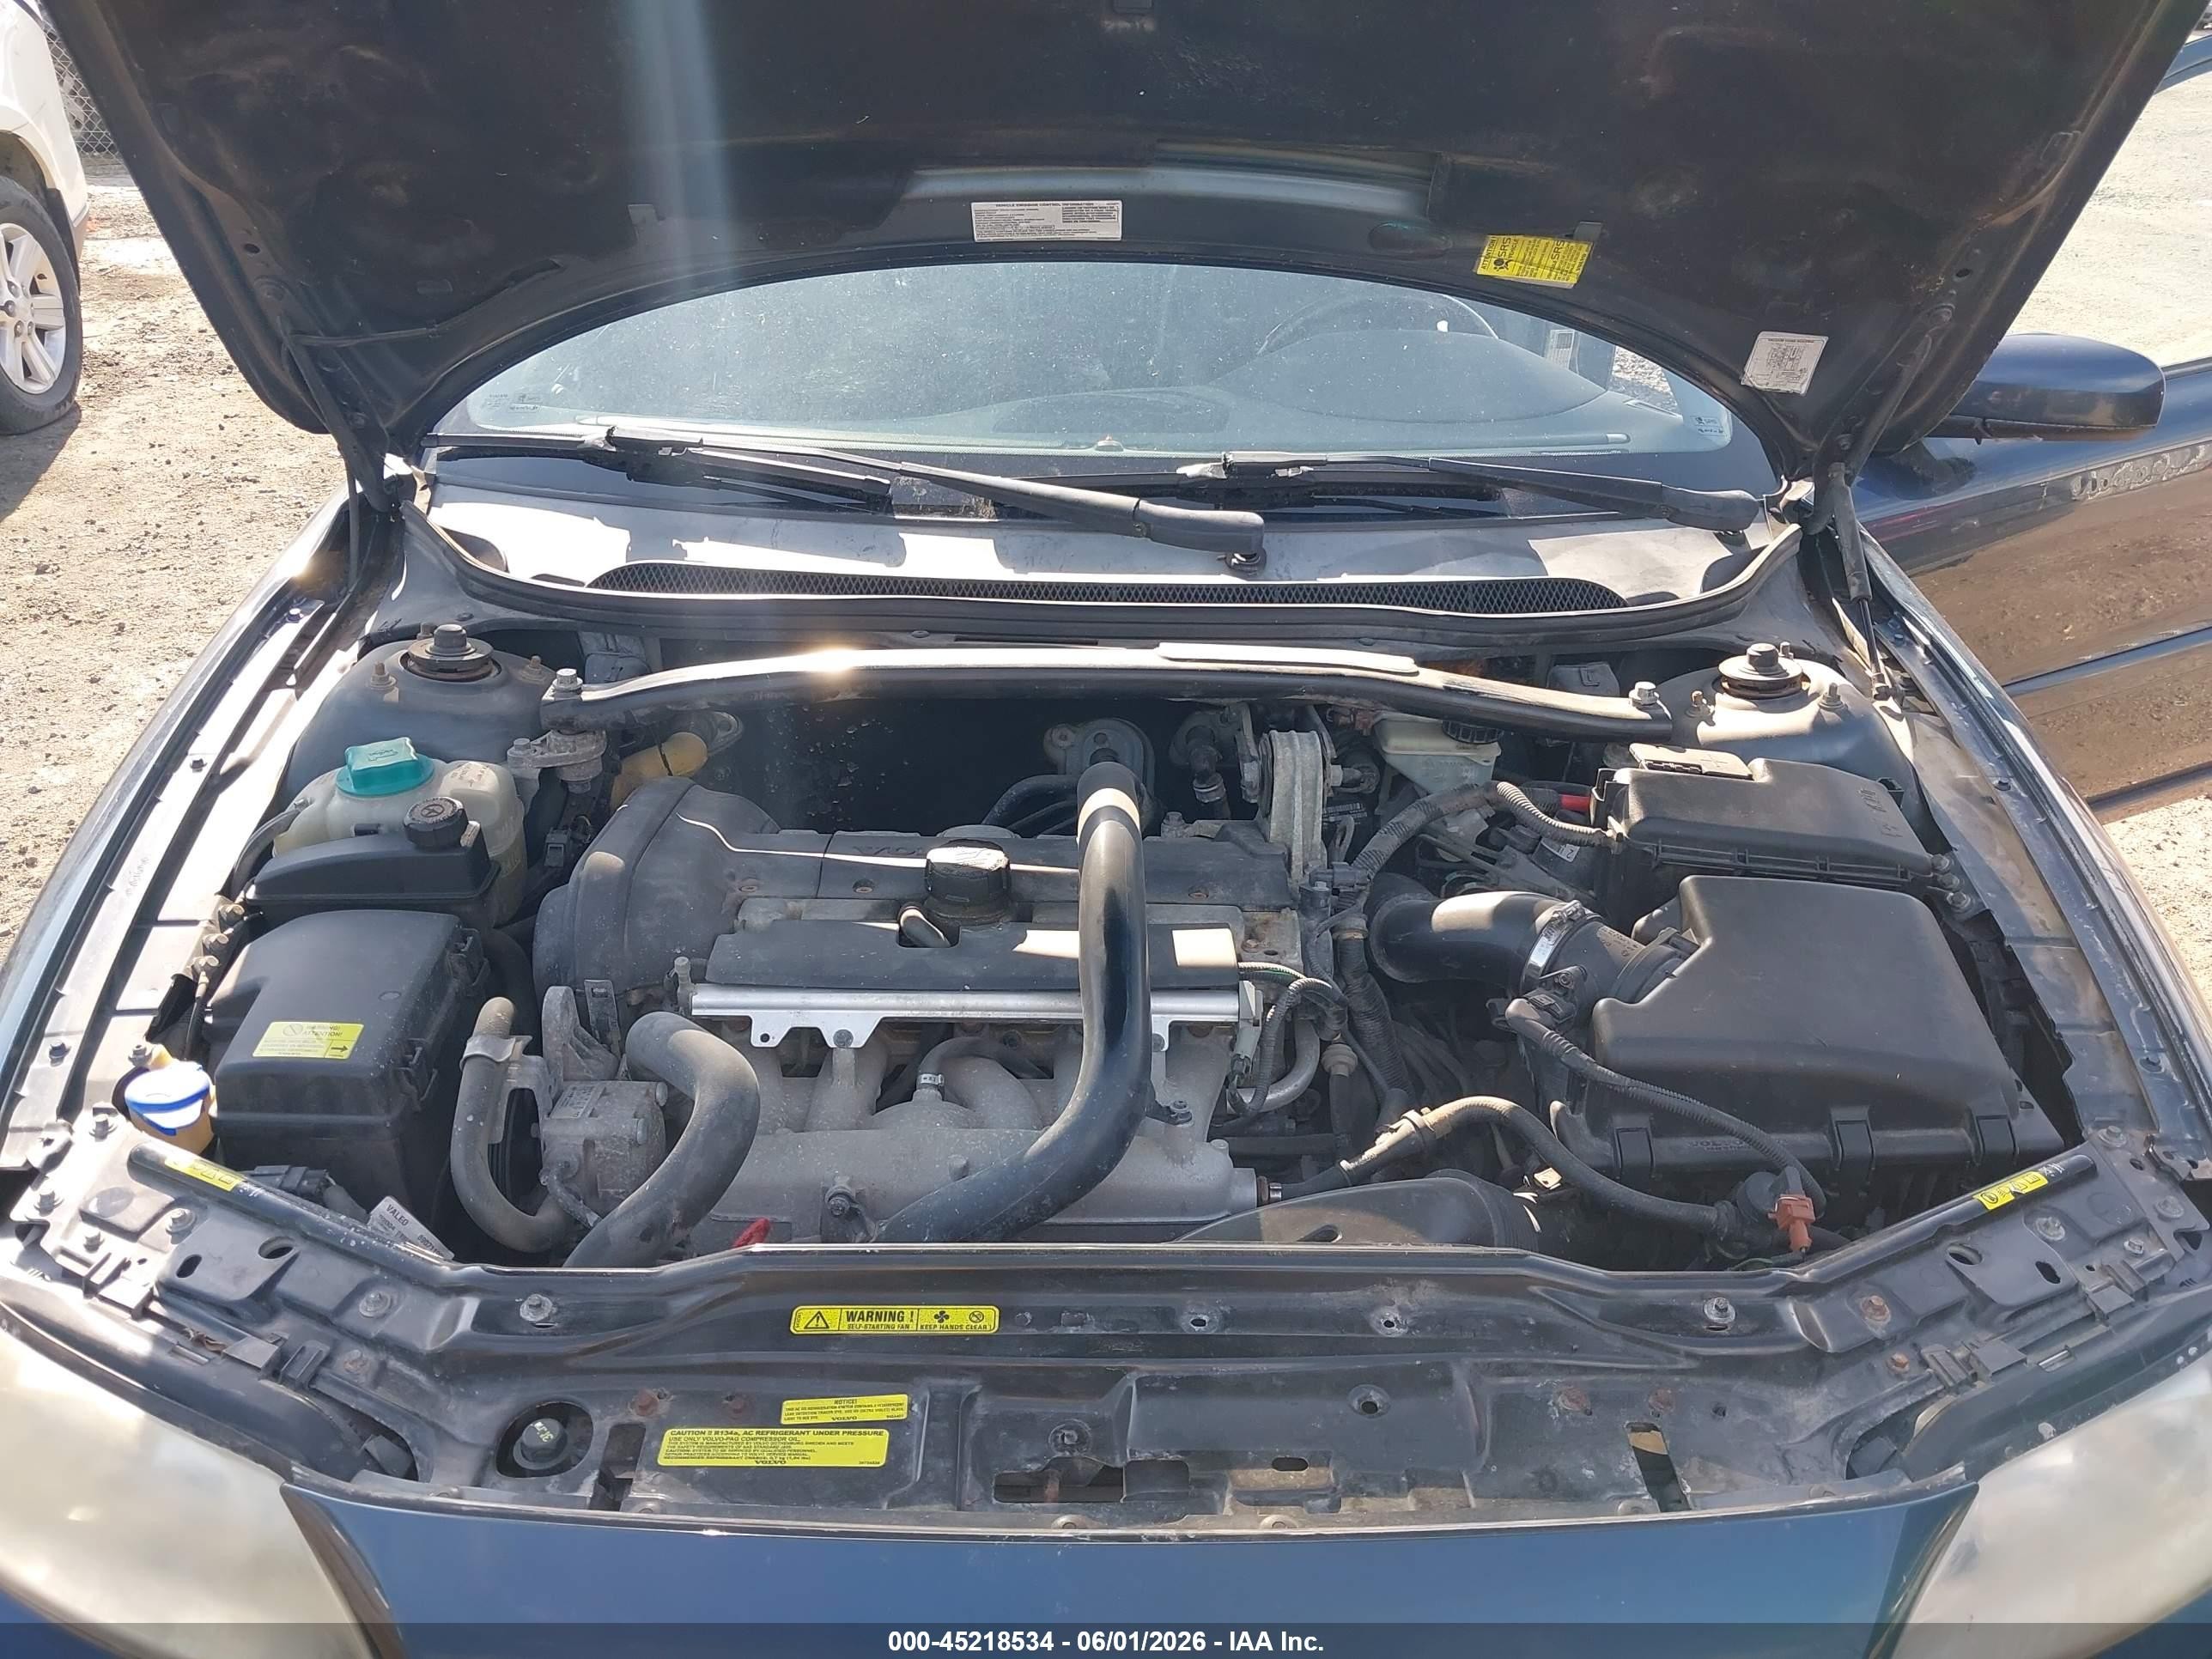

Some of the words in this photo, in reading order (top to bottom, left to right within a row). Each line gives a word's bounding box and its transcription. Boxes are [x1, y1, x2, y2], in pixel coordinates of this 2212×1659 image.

[1498, 237, 1512, 257] SRS
[1551, 240, 1565, 260] SRS
[386, 1204, 410, 1226] VALEO
[846, 1310, 905, 1322] WARNING
